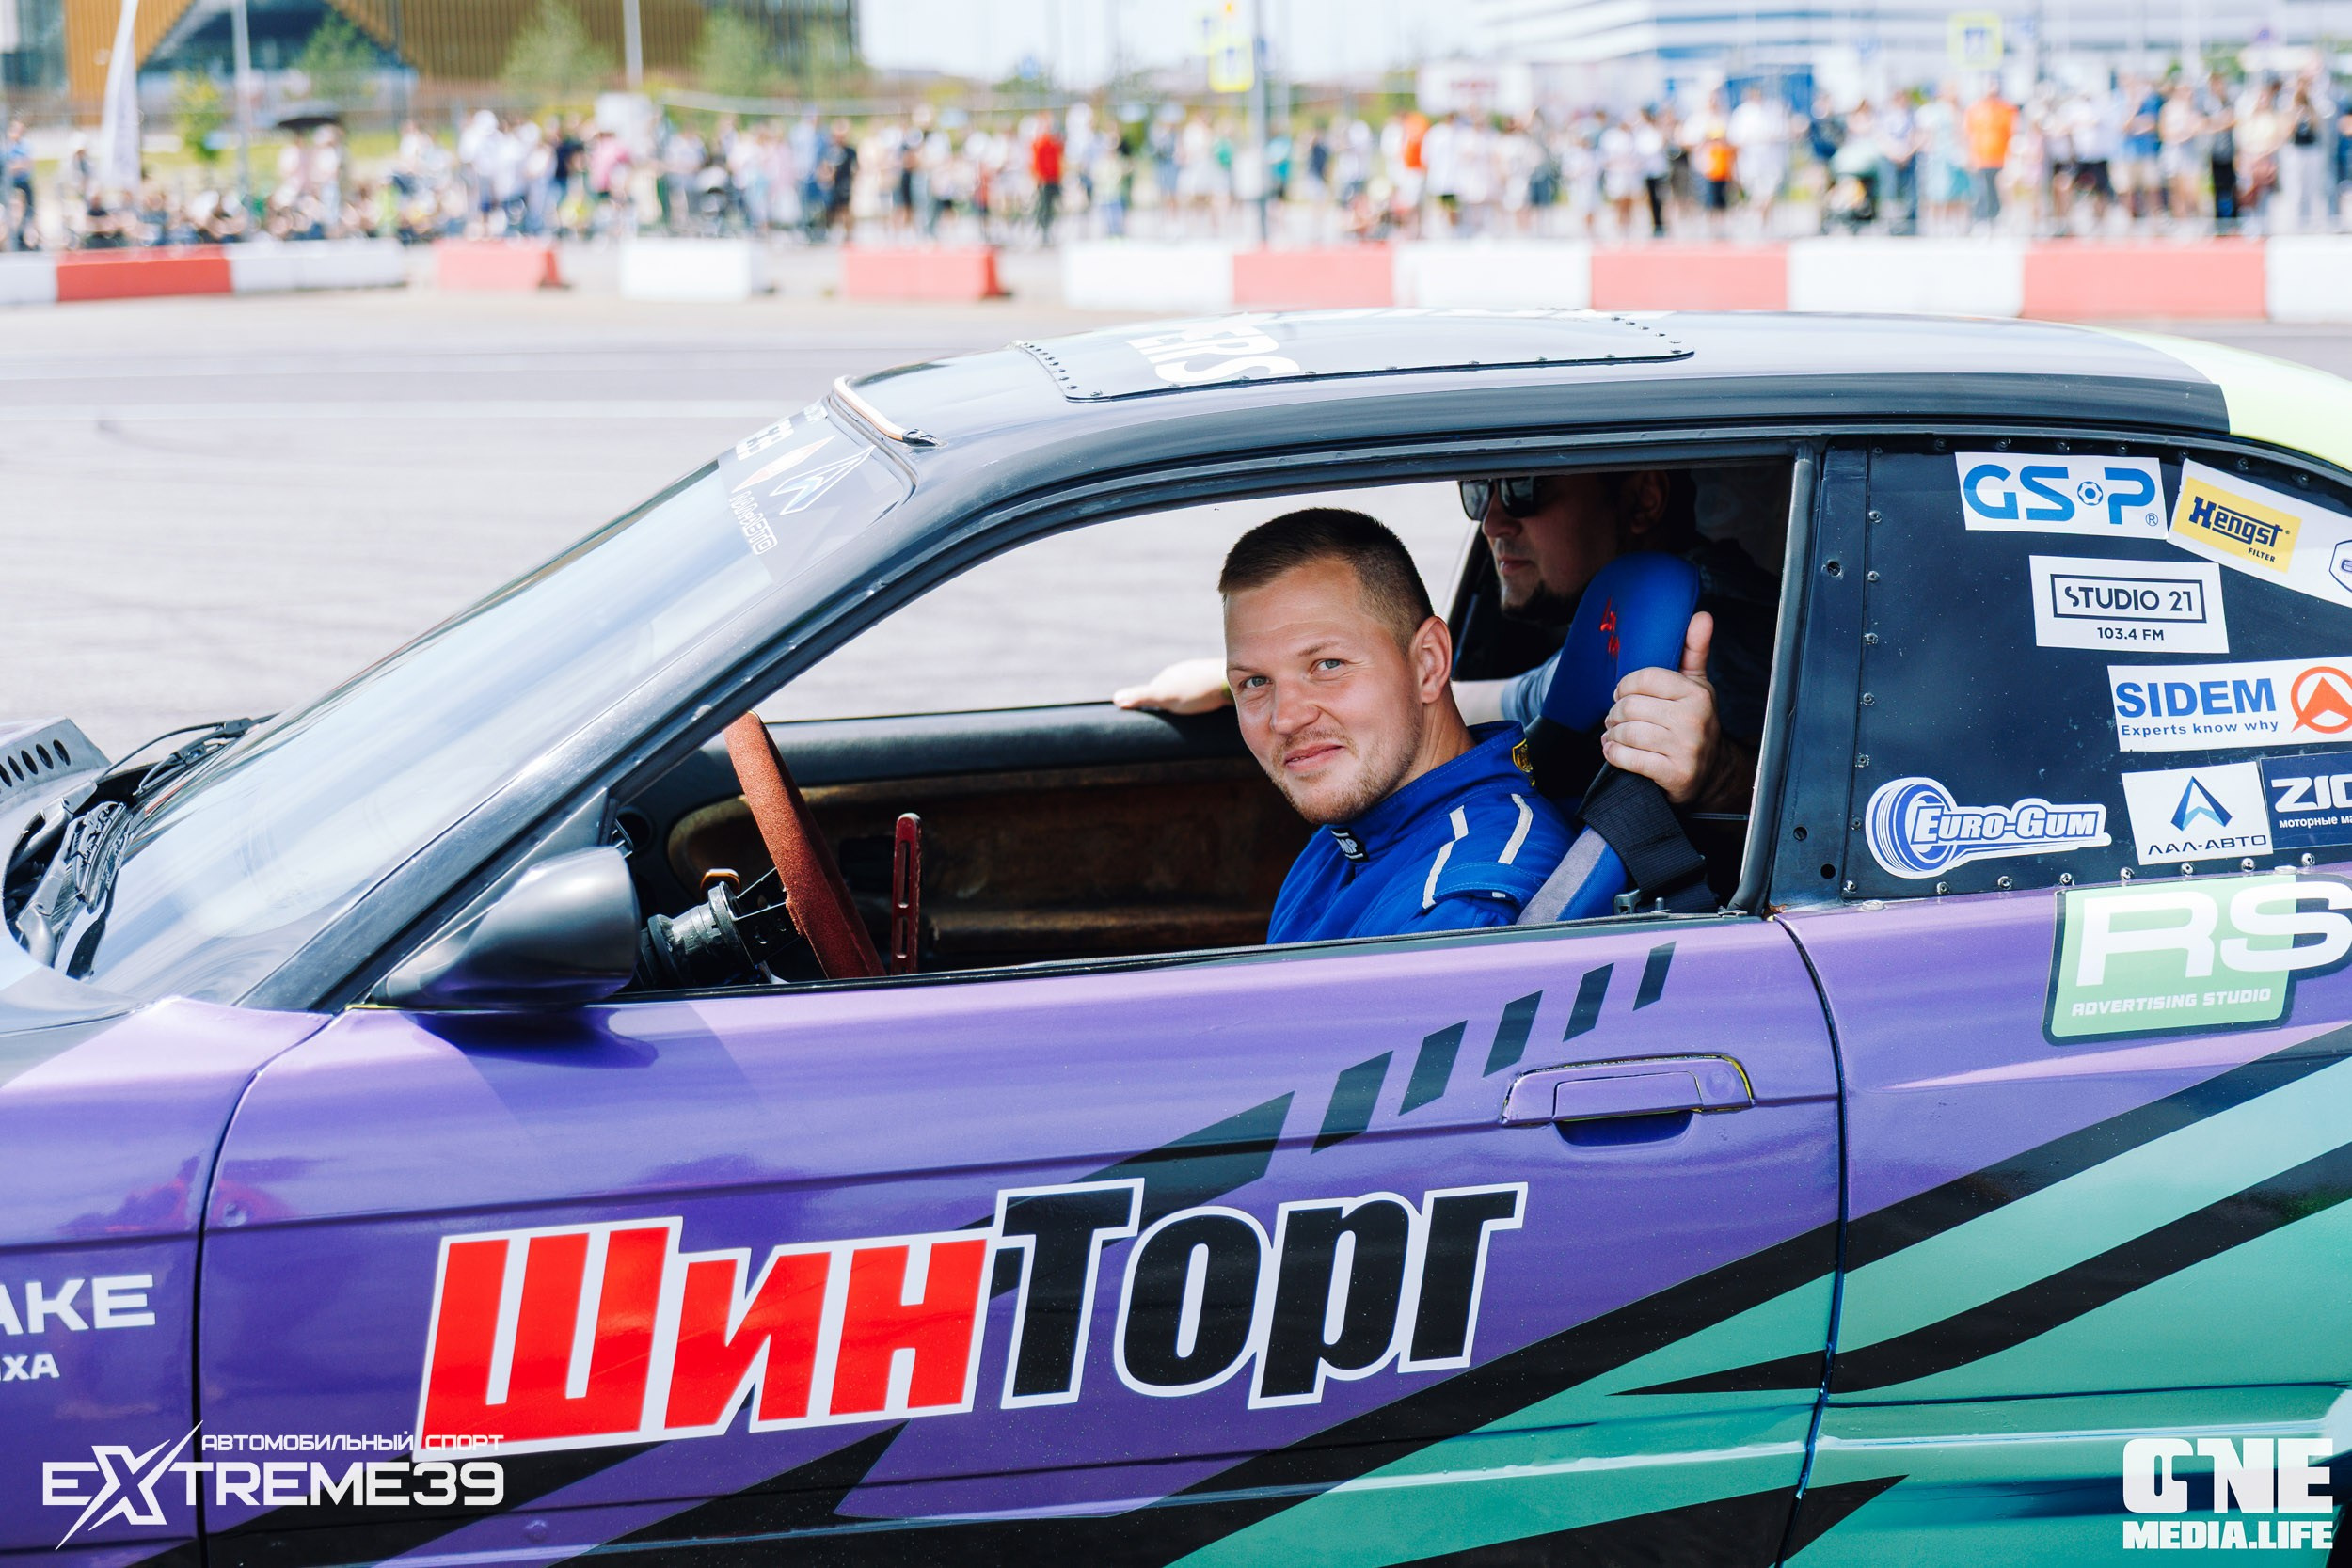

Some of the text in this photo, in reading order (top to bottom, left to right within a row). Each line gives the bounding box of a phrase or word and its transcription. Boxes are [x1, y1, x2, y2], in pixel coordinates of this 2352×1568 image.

[2188, 496, 2283, 547] Hengst
[2248, 547, 2276, 562] FILTER
[2064, 586, 2193, 611] STUDIO 21
[2097, 626, 2164, 641] 103.4 FM
[2116, 678, 2276, 718] SIDEM
[2122, 720, 2279, 737] Experts know why
[2279, 816, 2338, 829] моторные
[2076, 881, 2352, 986] RS
[2072, 988, 2272, 1017] ADVERTISING STUDIO
